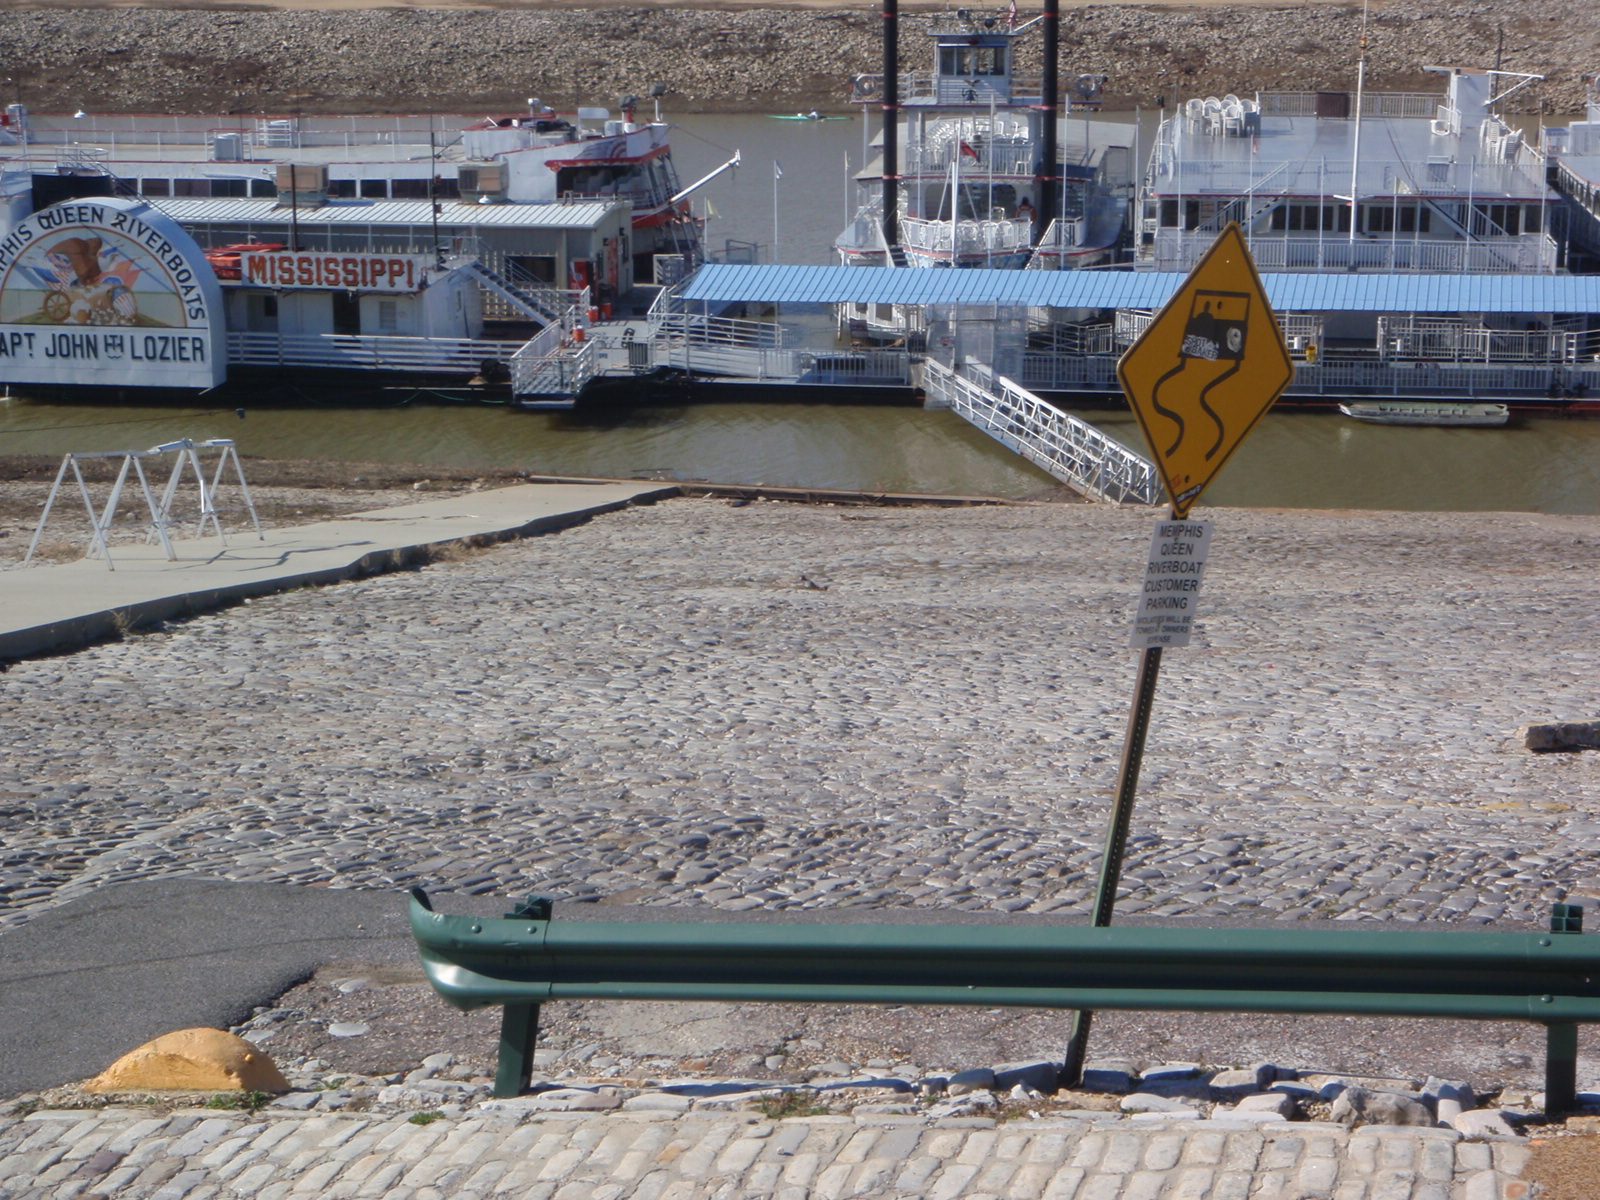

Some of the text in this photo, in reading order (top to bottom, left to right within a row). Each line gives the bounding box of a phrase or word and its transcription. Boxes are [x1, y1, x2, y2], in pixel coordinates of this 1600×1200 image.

[0, 206, 206, 320] PHIS QUEEN RIVERBOATS
[247, 255, 415, 288] MISSISSIPPI
[45, 333, 99, 359] JOHN
[130, 335, 205, 362] LOZIER
[1159, 525, 1204, 538] MEMPHIS
[1160, 543, 1194, 556] QUEEN
[1146, 561, 1203, 574] RIVERBOAT
[1144, 579, 1199, 593] CUSTOMER
[1146, 597, 1189, 611] PARKING
